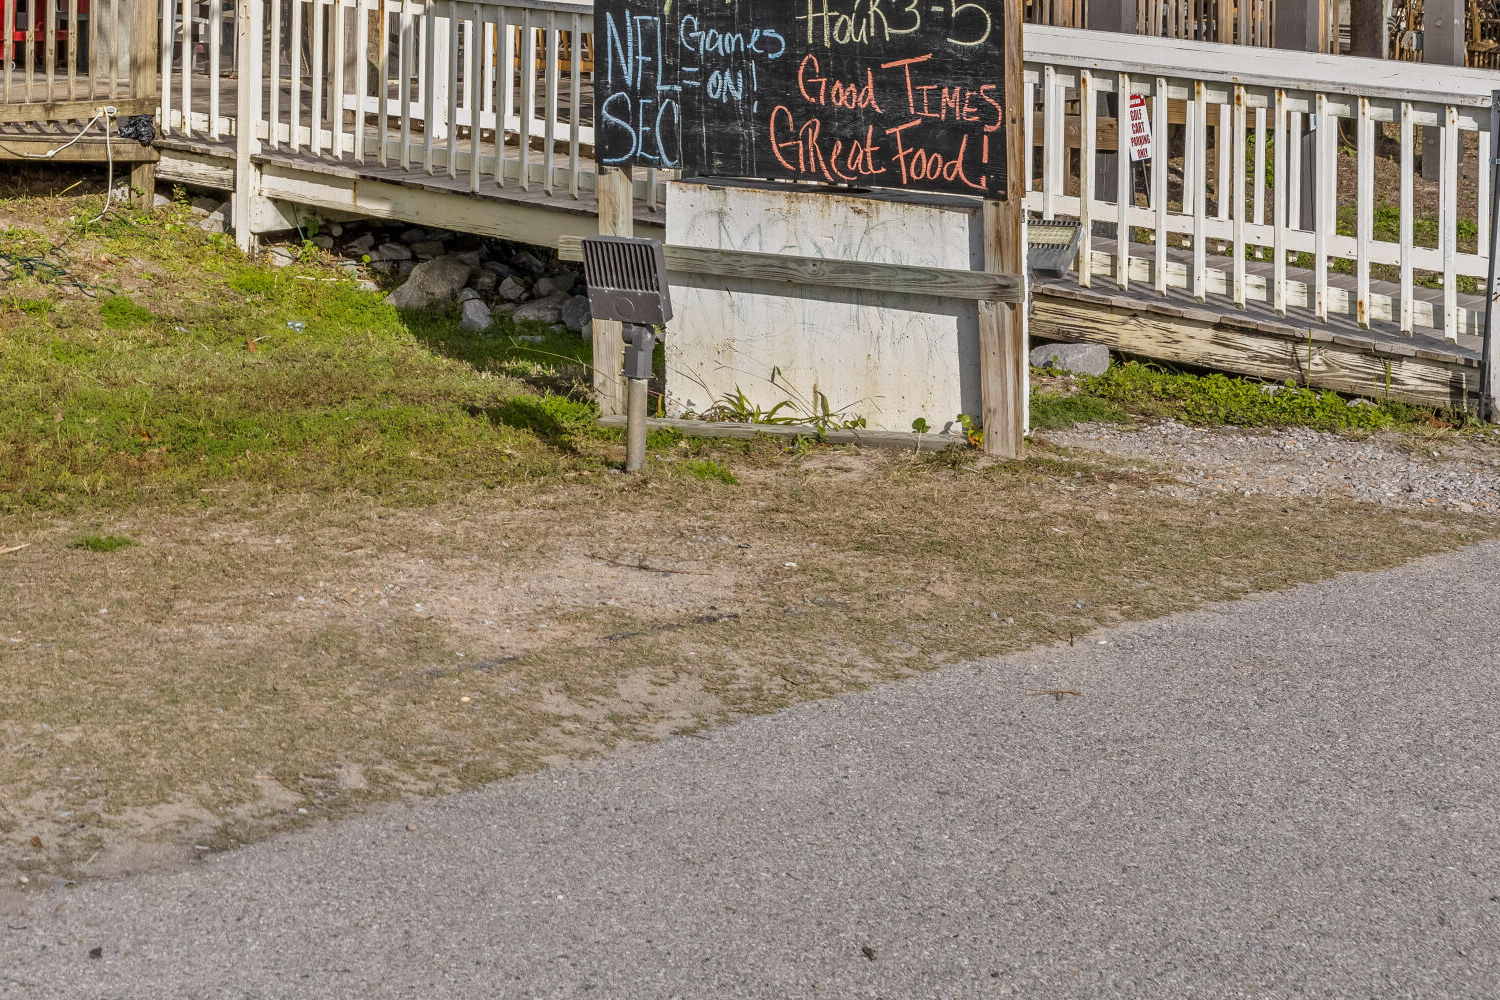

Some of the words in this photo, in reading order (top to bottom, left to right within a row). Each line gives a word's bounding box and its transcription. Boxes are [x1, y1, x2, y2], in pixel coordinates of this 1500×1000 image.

[605, 9, 682, 91] NFL
[680, 13, 786, 59] Games
[798, 53, 884, 114] Good
[881, 53, 1003, 132] TIMES
[1130, 108, 1142, 121] GOLF
[602, 92, 680, 167] SEC
[1130, 134, 1151, 147] PARKING
[1131, 121, 1145, 134] CART
